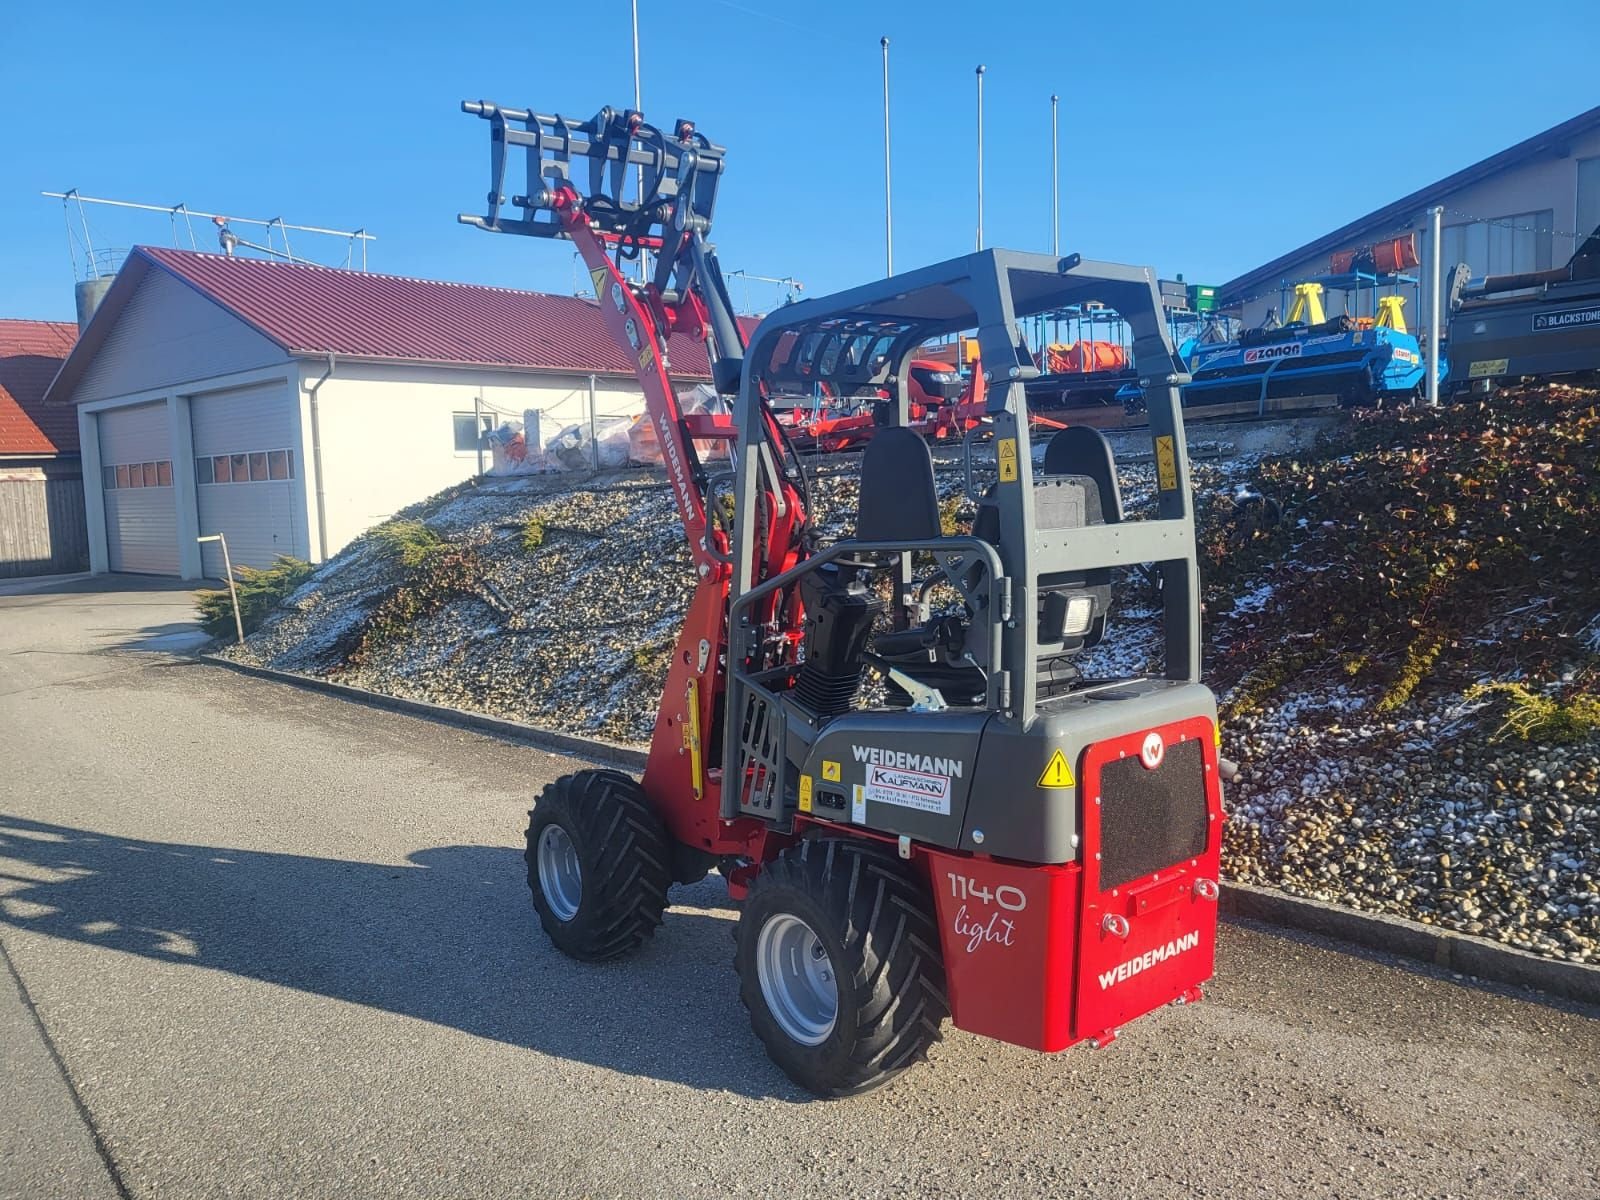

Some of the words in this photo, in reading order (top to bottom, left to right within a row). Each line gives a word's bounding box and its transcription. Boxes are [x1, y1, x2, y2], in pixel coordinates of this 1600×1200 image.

[1548, 311, 1600, 326] BLACKSTONE
[1258, 344, 1300, 359] zanon
[659, 412, 694, 520] WEIDEMANN
[852, 744, 963, 778] WEIDEMANN
[947, 872, 1027, 911] 1140
[954, 904, 1016, 953] light
[1098, 929, 1199, 991] WEIDEMANN
